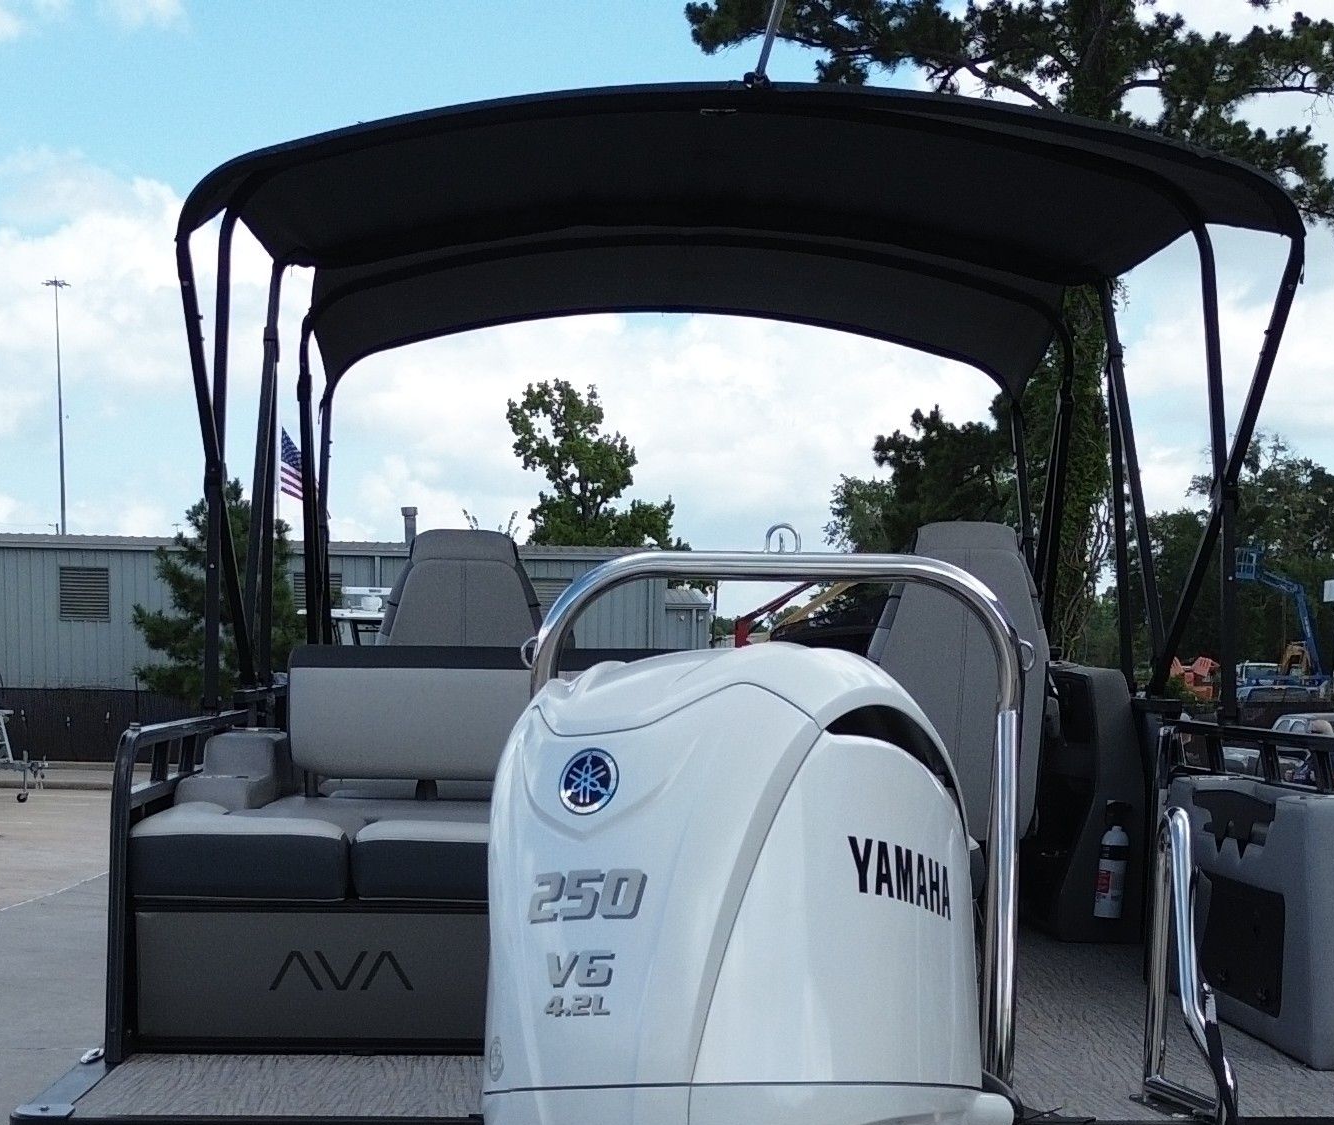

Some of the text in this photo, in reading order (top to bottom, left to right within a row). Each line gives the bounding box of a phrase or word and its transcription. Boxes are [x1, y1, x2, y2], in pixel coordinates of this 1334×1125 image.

[528, 868, 648, 924] 250
[848, 836, 951, 921] YAMAHA
[269, 950, 413, 990] AVA
[546, 950, 616, 988] V6
[544, 994, 611, 1017] 4.2L
